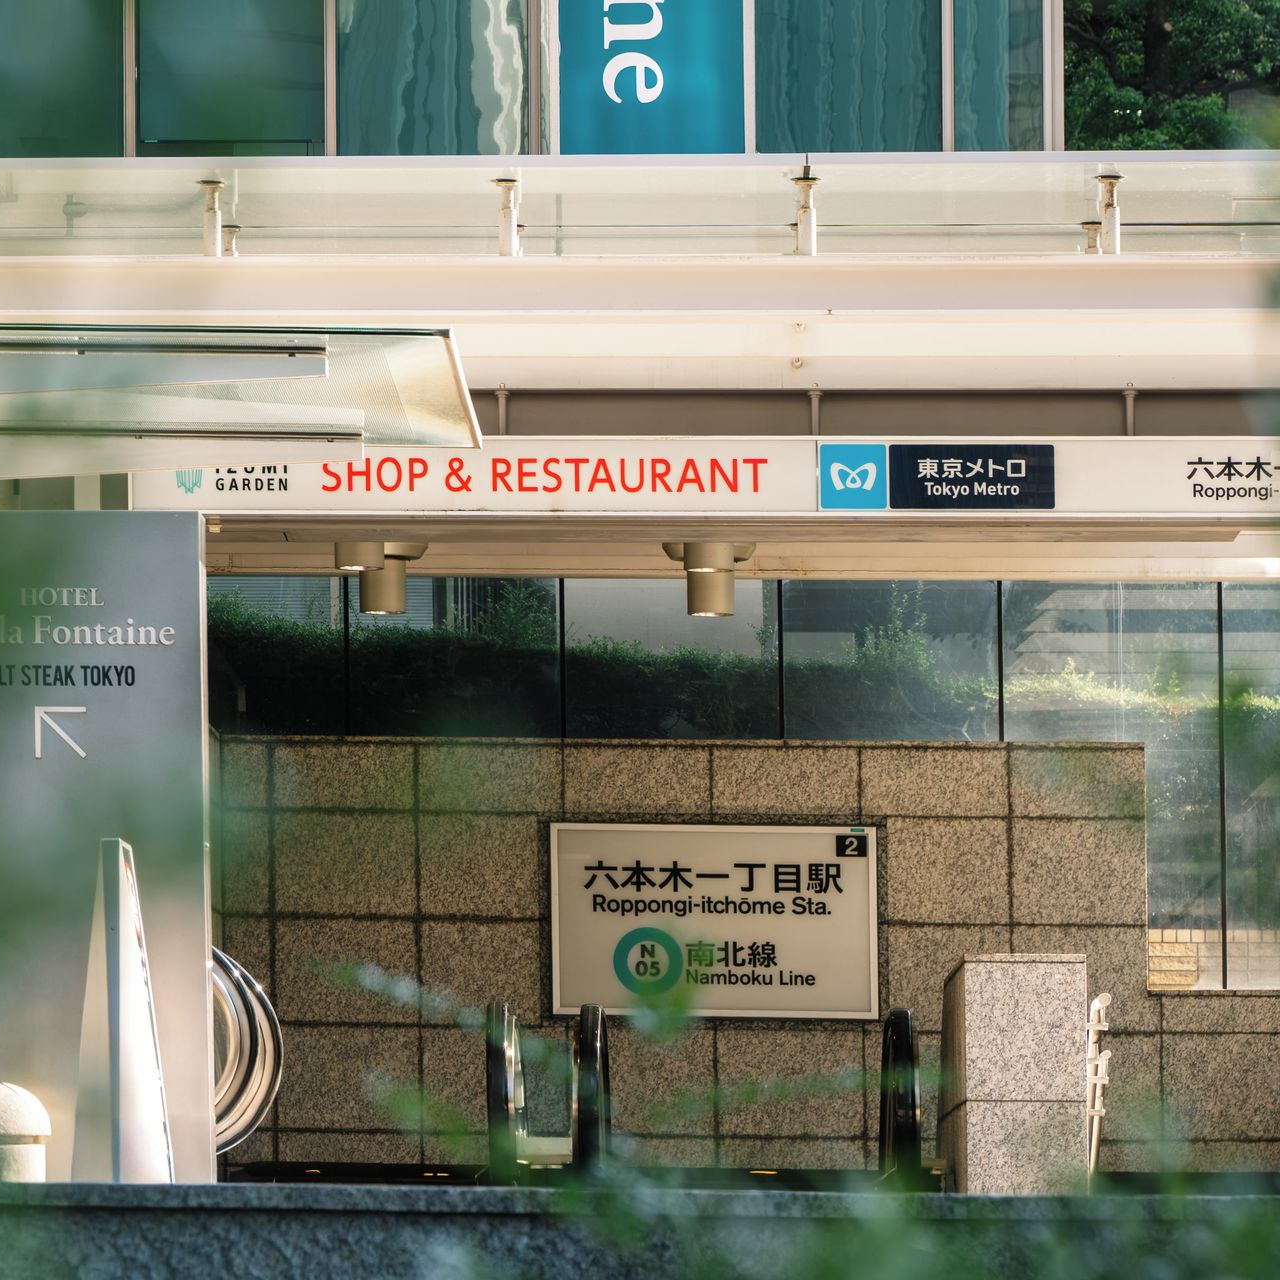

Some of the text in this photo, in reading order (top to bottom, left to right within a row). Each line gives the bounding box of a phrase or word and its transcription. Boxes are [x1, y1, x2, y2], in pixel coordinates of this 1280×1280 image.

[321, 457, 769, 493] SHOP & RESTAURANT
[917, 458, 1026, 479] 東京メトロ
[216, 478, 288, 491] GARDEN
[924, 482, 1020, 499] Tokyo Metro
[20, 587, 105, 607] HOTEL
[32, 615, 177, 646] Fontaine
[21, 665, 77, 687] STEAK
[81, 665, 136, 687] TOKYO
[844, 837, 859, 855] 2
[584, 860, 844, 894] 六本木一丁目駅
[592, 894, 832, 917] Roppongi-itchōme Sta.
[640, 944, 655, 959] N
[685, 940, 778, 968] 南北線
[635, 961, 661, 977] 05
[685, 969, 816, 987] Namboku Line
